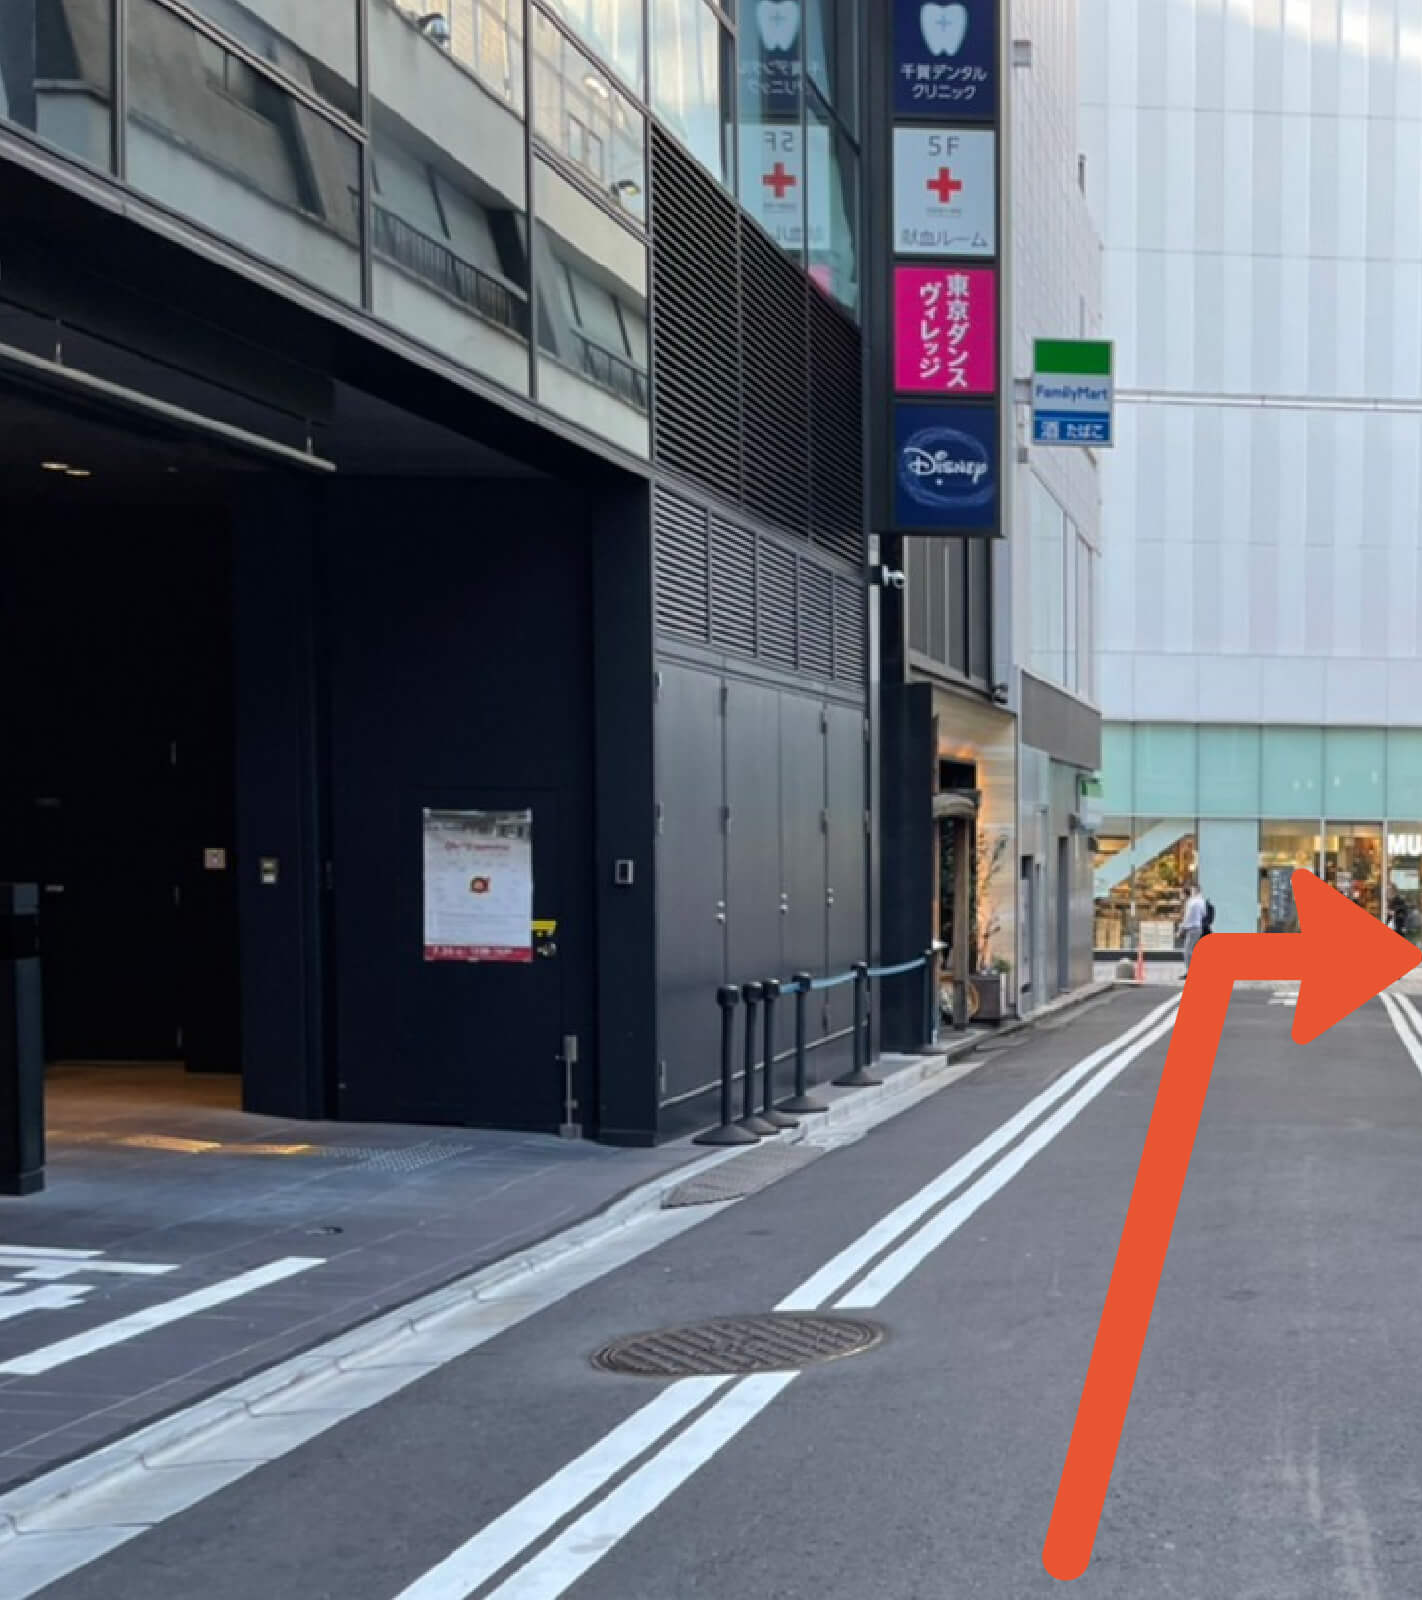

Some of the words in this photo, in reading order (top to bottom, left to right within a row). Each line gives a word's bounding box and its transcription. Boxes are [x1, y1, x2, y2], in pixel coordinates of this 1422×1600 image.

[911, 84, 976, 99] クリニック
[920, 282, 942, 378] ヴィレッジ
[946, 274, 970, 388] 東京ダンス
[1036, 385, 1108, 402] FamilyMart
[903, 447, 988, 484] Disney
